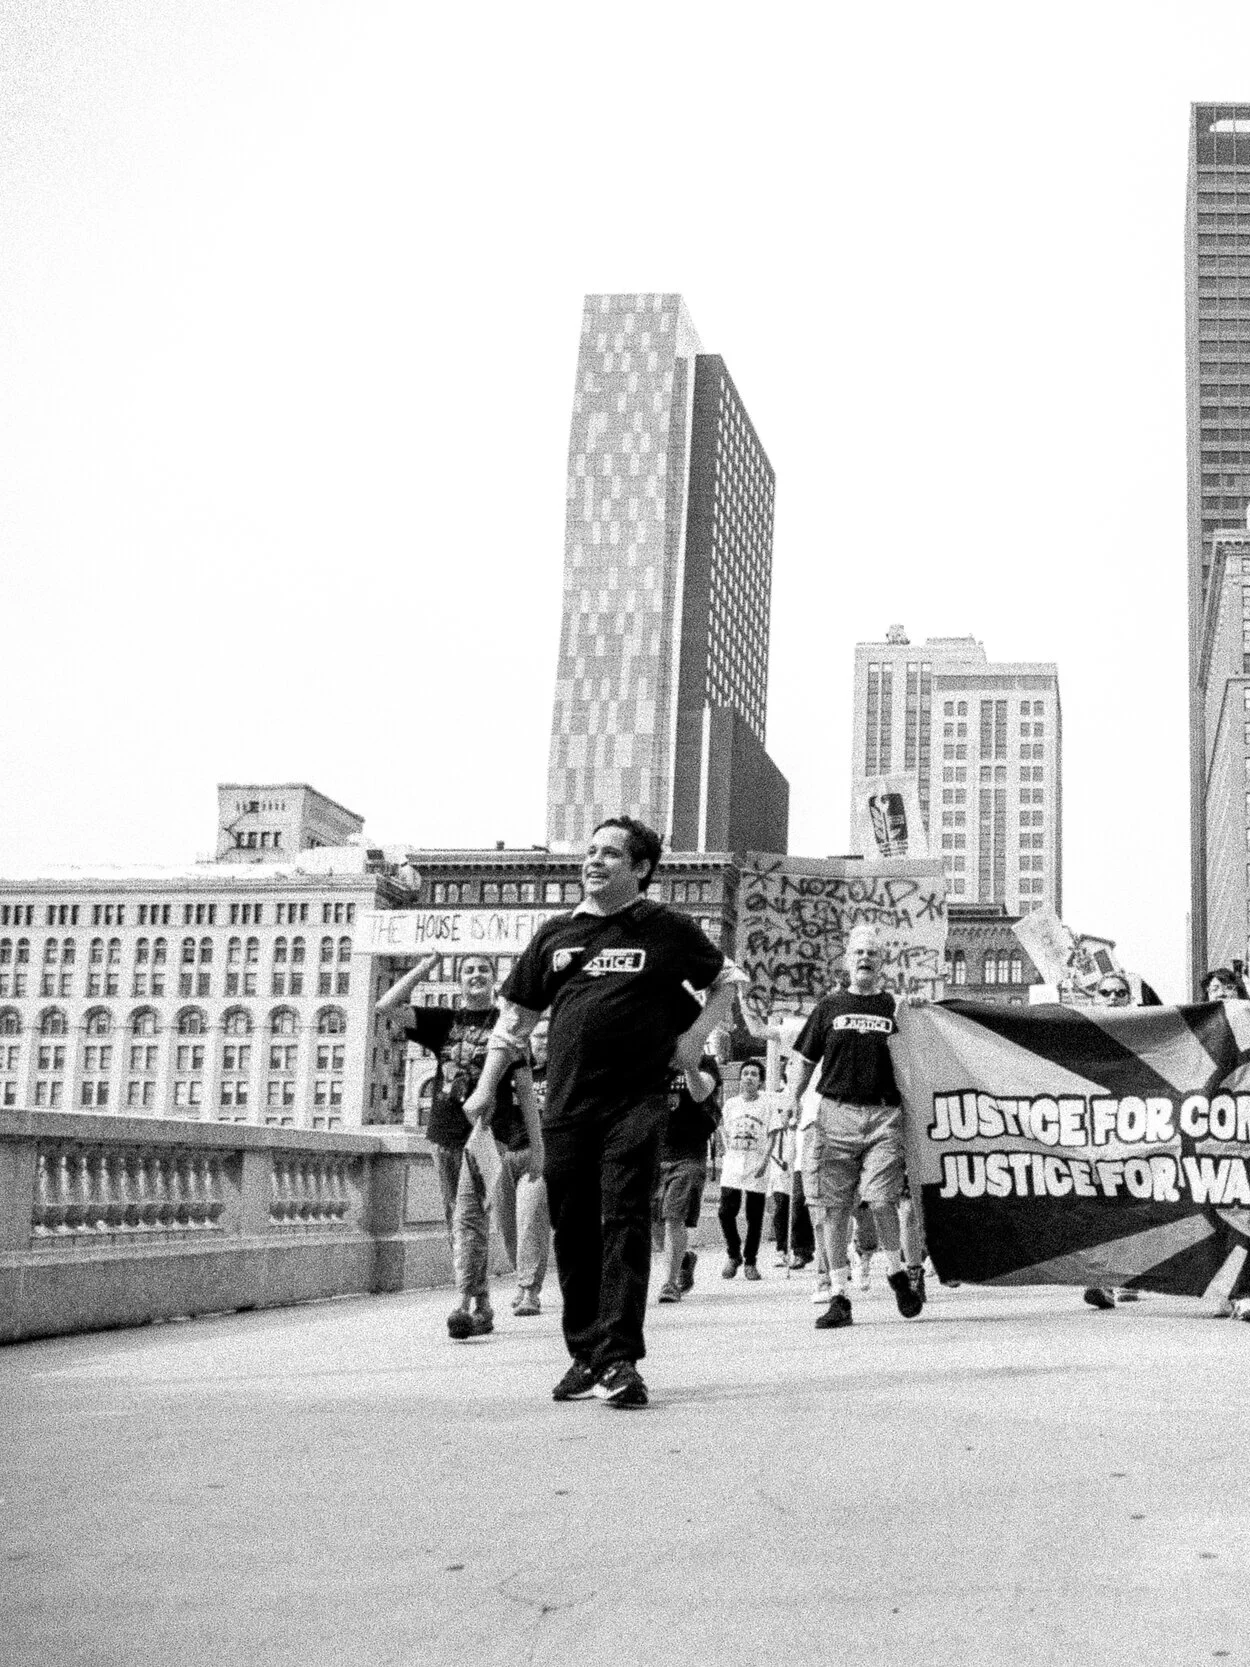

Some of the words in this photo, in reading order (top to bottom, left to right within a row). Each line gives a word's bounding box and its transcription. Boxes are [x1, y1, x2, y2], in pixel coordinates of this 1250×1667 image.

[364, 914, 408, 944] THE
[414, 913, 462, 943] HOUSE
[930, 1093, 1088, 1147] JUSTICE
[1091, 1095, 1176, 1146] FOR
[939, 1153, 1098, 1198] JUSTICE
[1096, 1156, 1180, 1203] FOR
